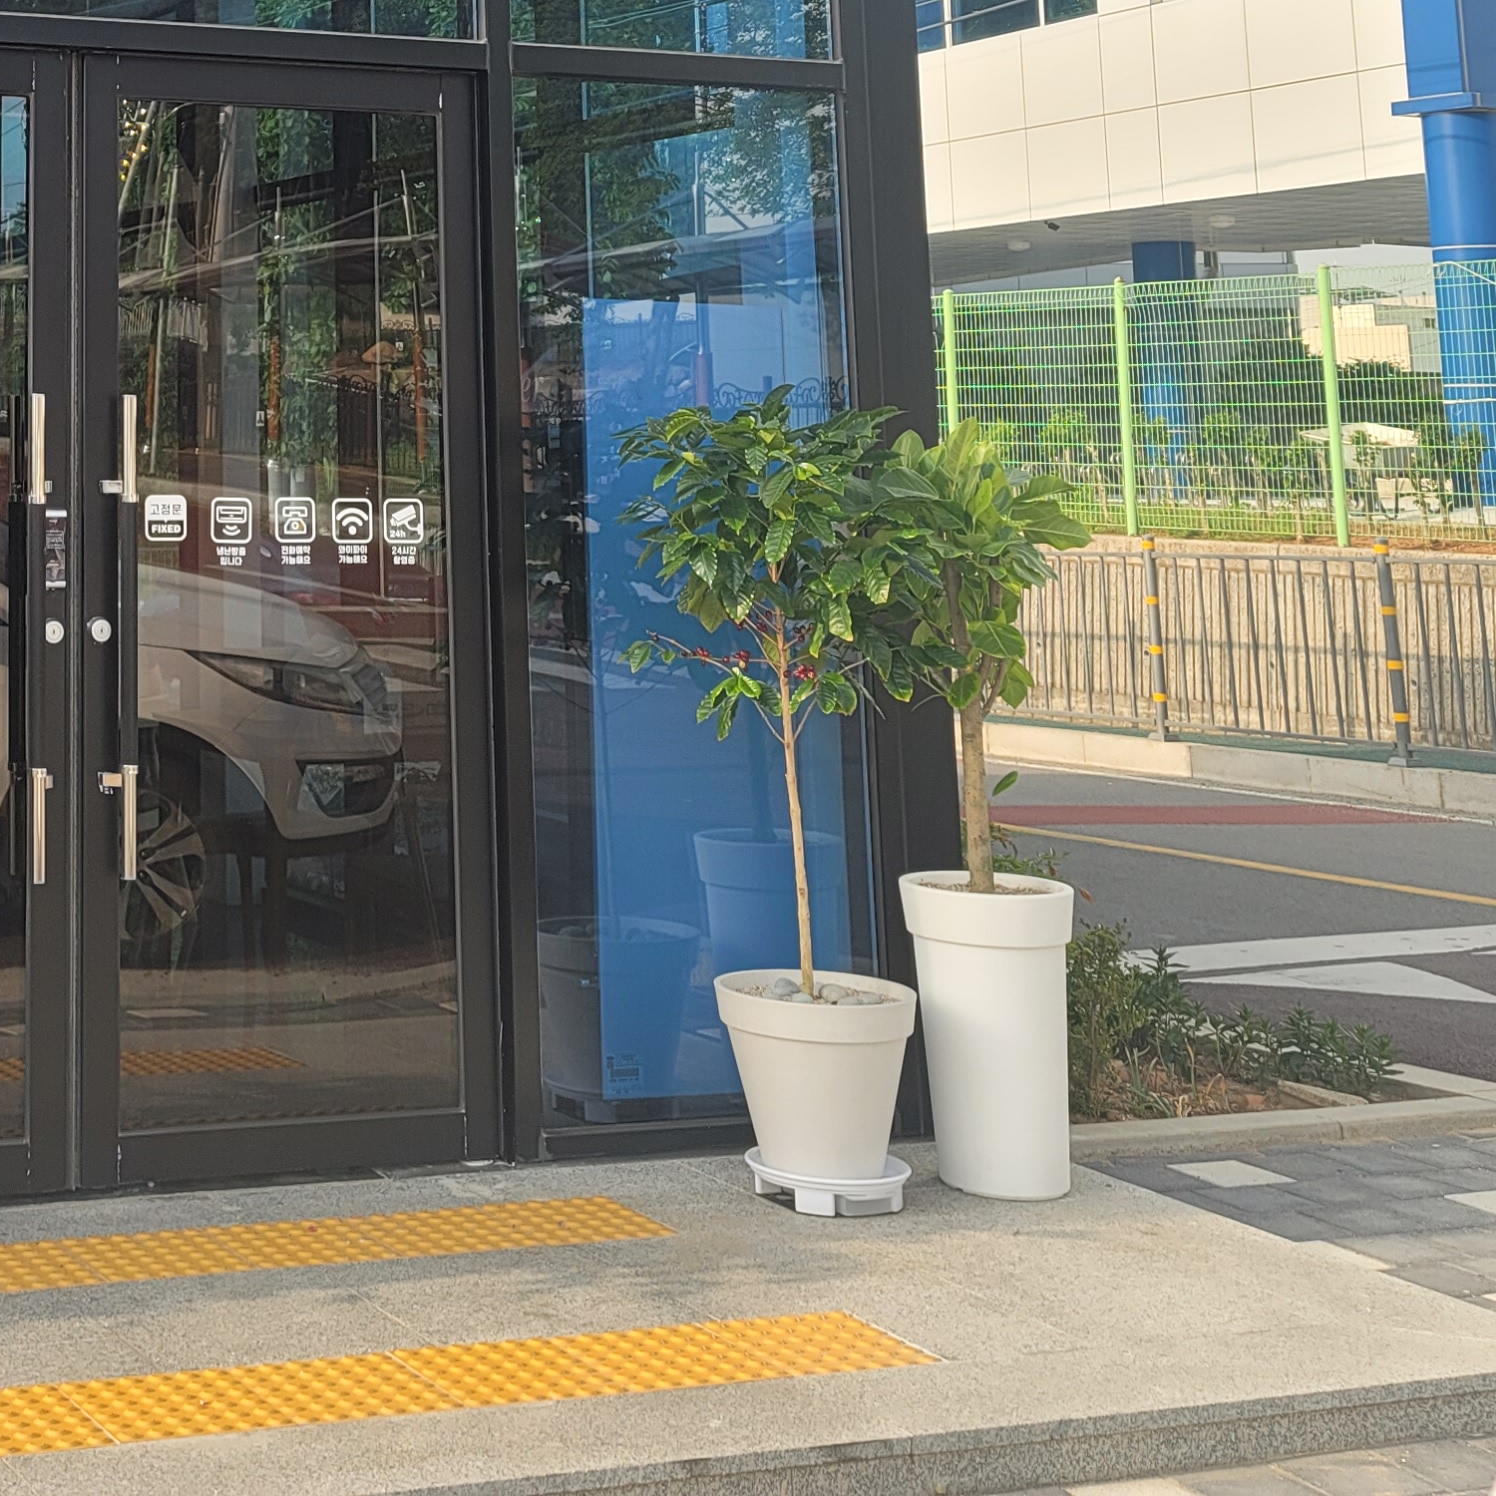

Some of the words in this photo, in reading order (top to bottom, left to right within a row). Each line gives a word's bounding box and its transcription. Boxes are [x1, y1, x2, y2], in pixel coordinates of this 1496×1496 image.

[150, 503, 182, 515] 고정문
[151, 524, 181, 533] FIXED
[389, 529, 406, 538] 24h
[338, 545, 368, 554] 와이파이
[391, 546, 416, 555] 24시간
